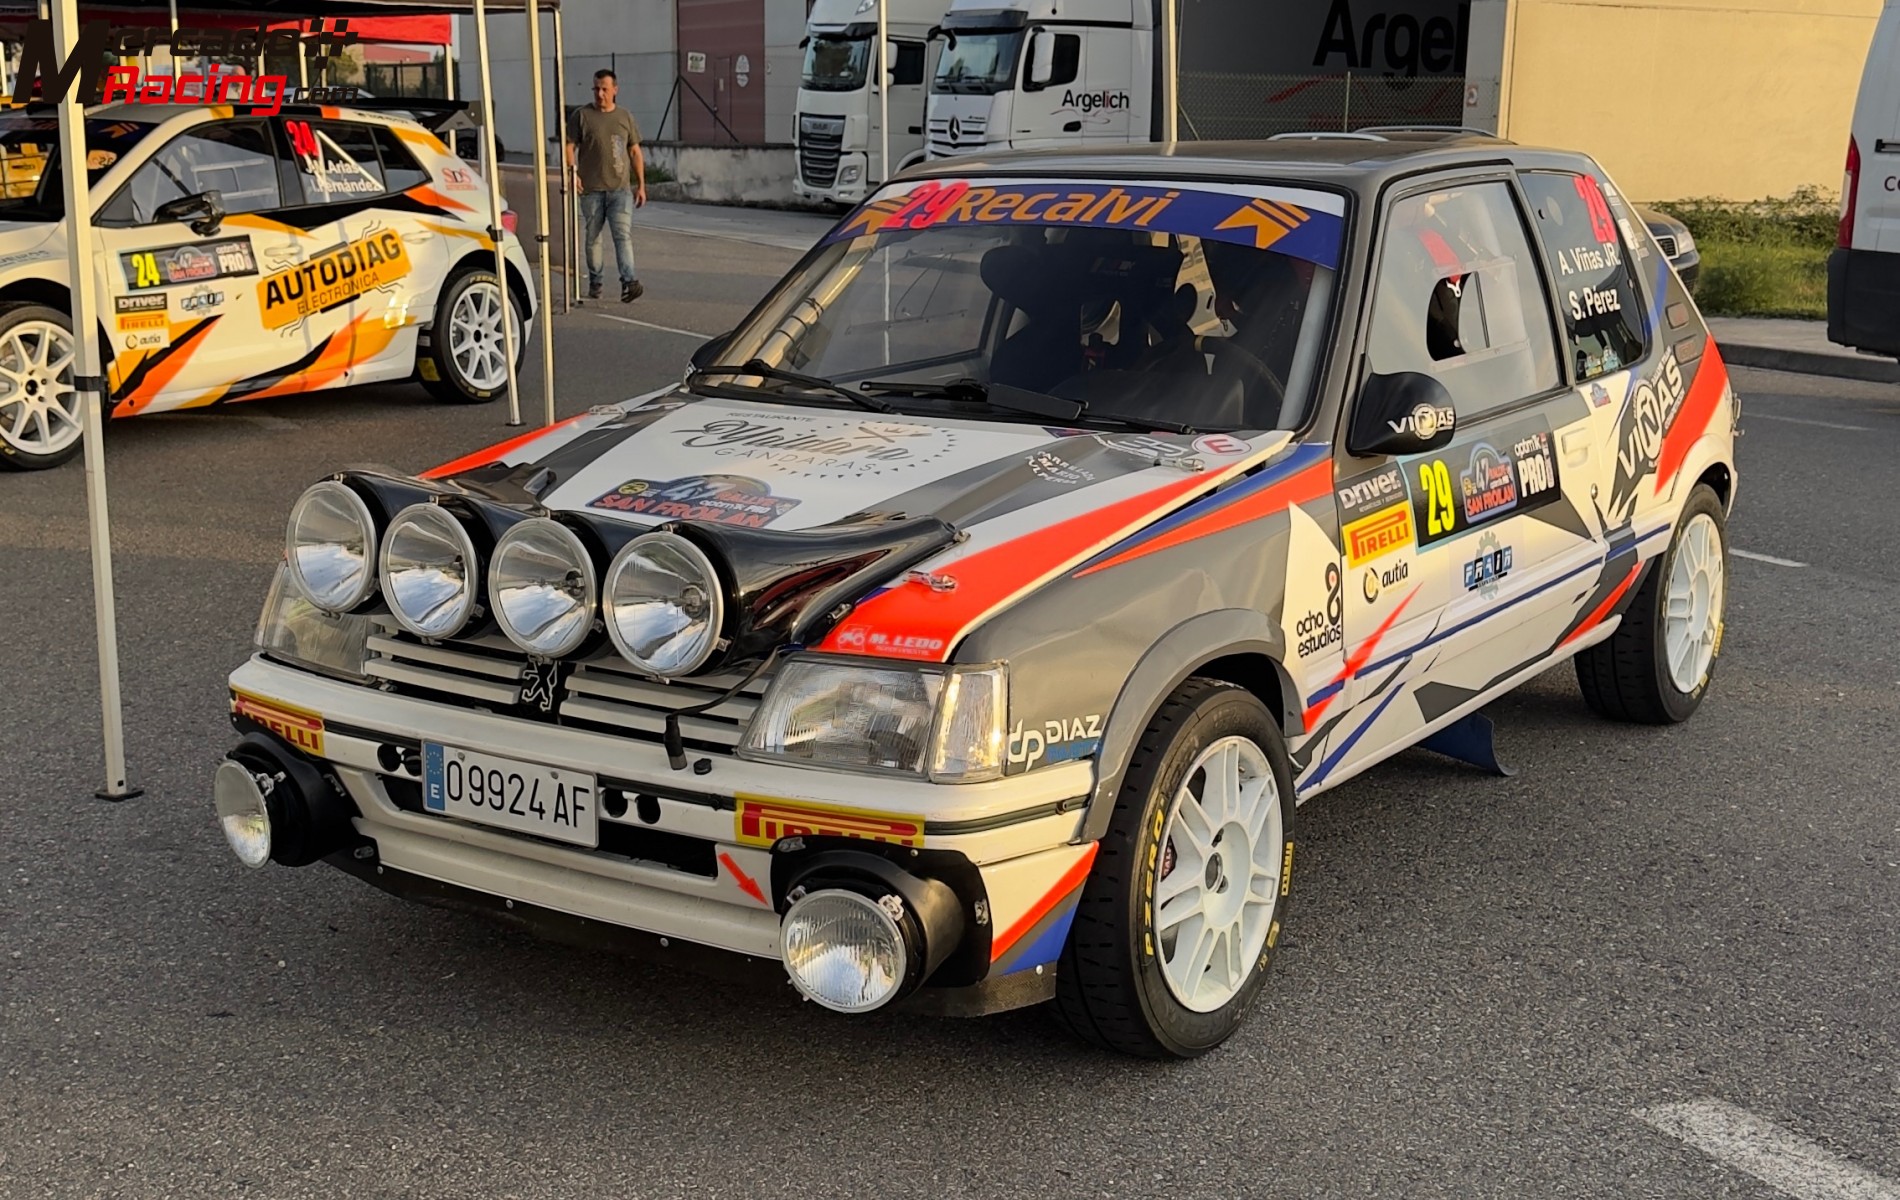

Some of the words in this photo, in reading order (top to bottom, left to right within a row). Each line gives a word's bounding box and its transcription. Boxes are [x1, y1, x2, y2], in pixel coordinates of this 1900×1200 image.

[1062, 90, 1129, 112] Argelich
[286, 121, 319, 156] 24
[442, 168, 472, 183] SDS
[882, 180, 970, 229] 29
[944, 187, 1179, 227] Recalvi
[132, 253, 160, 287] 24
[266, 233, 401, 310] AUTODIAG
[1558, 251, 1573, 276] A.
[1571, 247, 1604, 271] Viñas
[1603, 242, 1621, 267] JR.
[1569, 291, 1585, 321] S.
[1583, 285, 1620, 317] Pérez
[120, 314, 164, 329] PIRELLI
[1618, 355, 1684, 479] VIÑAS
[1203, 438, 1243, 454] E
[595, 494, 652, 513] SAN
[1419, 460, 1455, 536] 29
[1467, 495, 1484, 516] SAN
[1483, 483, 1516, 511] FROILAN
[1350, 511, 1409, 560] PIRELLI
[1382, 558, 1408, 588] autia
[1297, 610, 1324, 637] ocho
[893, 636, 943, 650] LEDO
[1298, 624, 1340, 658] estudios
[1045, 714, 1102, 745] DIAZ
[431, 784, 440, 799] E
